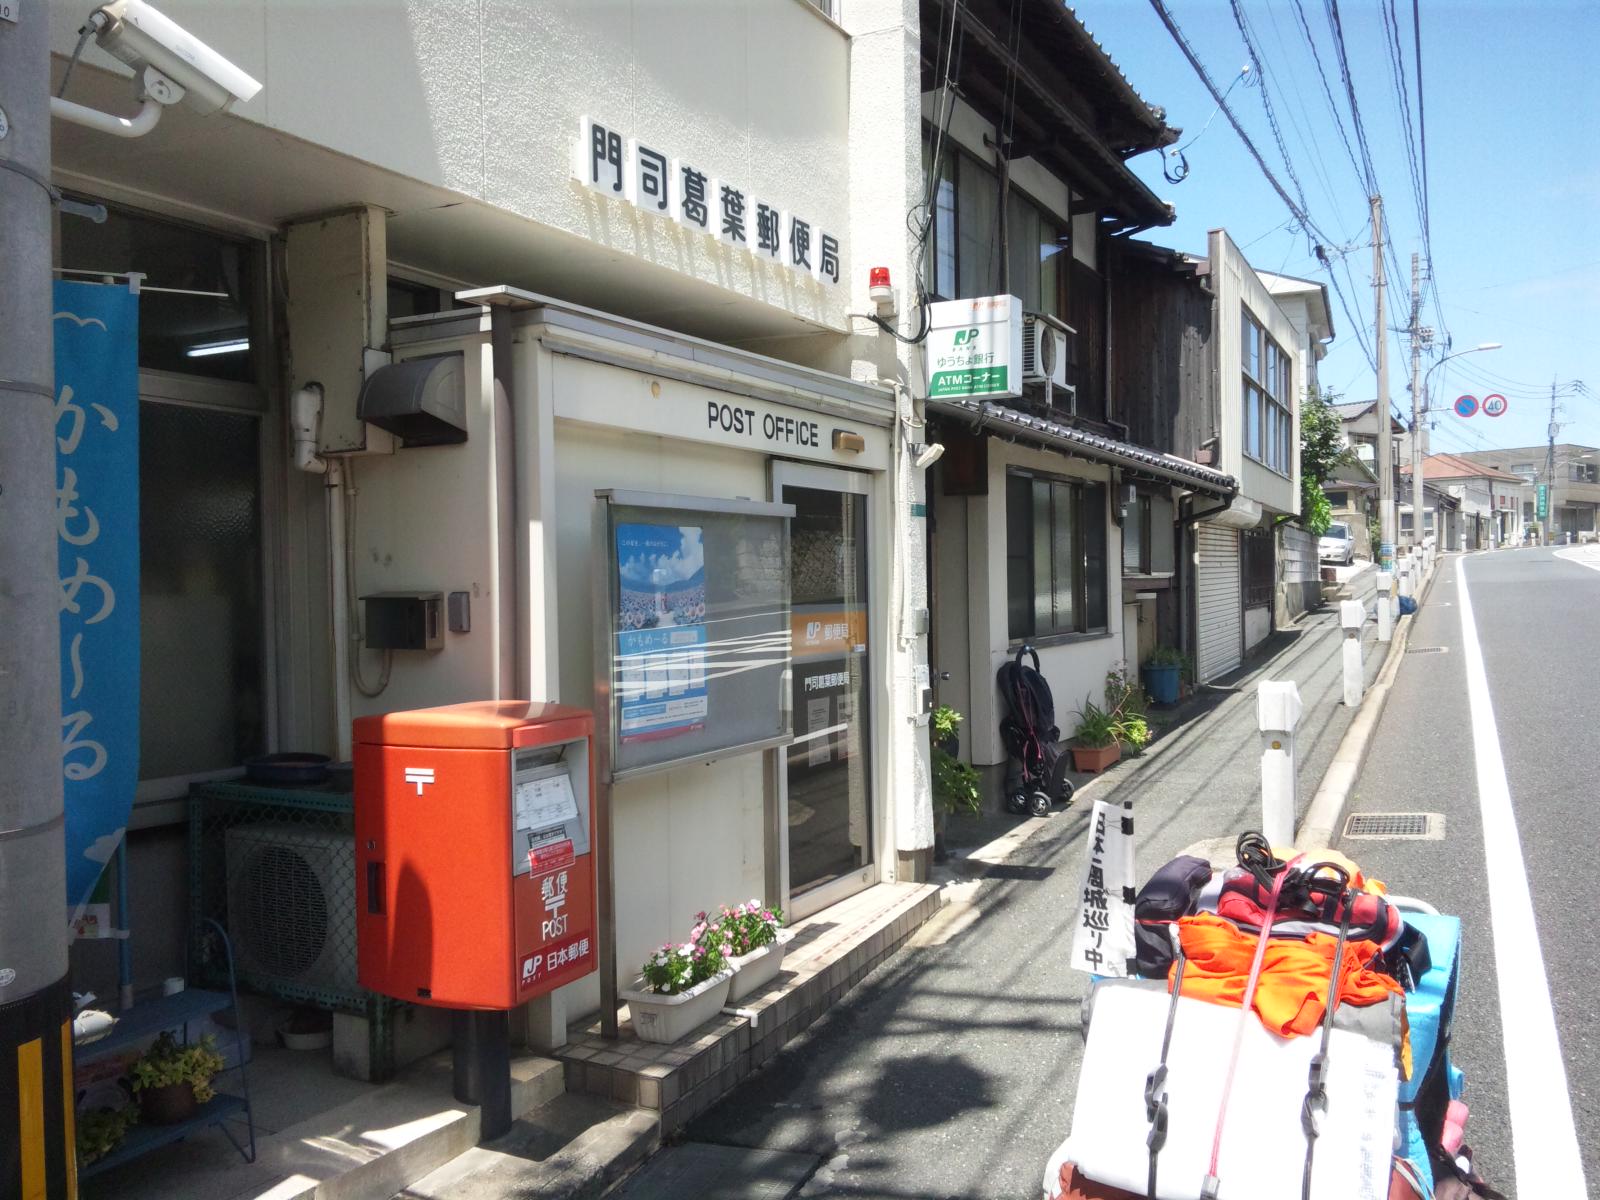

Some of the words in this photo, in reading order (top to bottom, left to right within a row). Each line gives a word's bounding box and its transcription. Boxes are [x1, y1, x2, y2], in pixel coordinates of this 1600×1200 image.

[592, 123, 840, 284] 門司葛葉郵便局
[954, 328, 980, 346] JP
[937, 352, 995, 368] ゆうちょ銀行
[1487, 400, 1502, 411] 40
[707, 401, 755, 436] POST
[763, 413, 819, 448] OFFICE
[541, 870, 569, 901] 郵便
[1083, 812, 1110, 971] 日本一周城巡り中
[542, 914, 569, 942] POST
[522, 954, 543, 979] JP
[547, 937, 589, 972] 日本郵便
